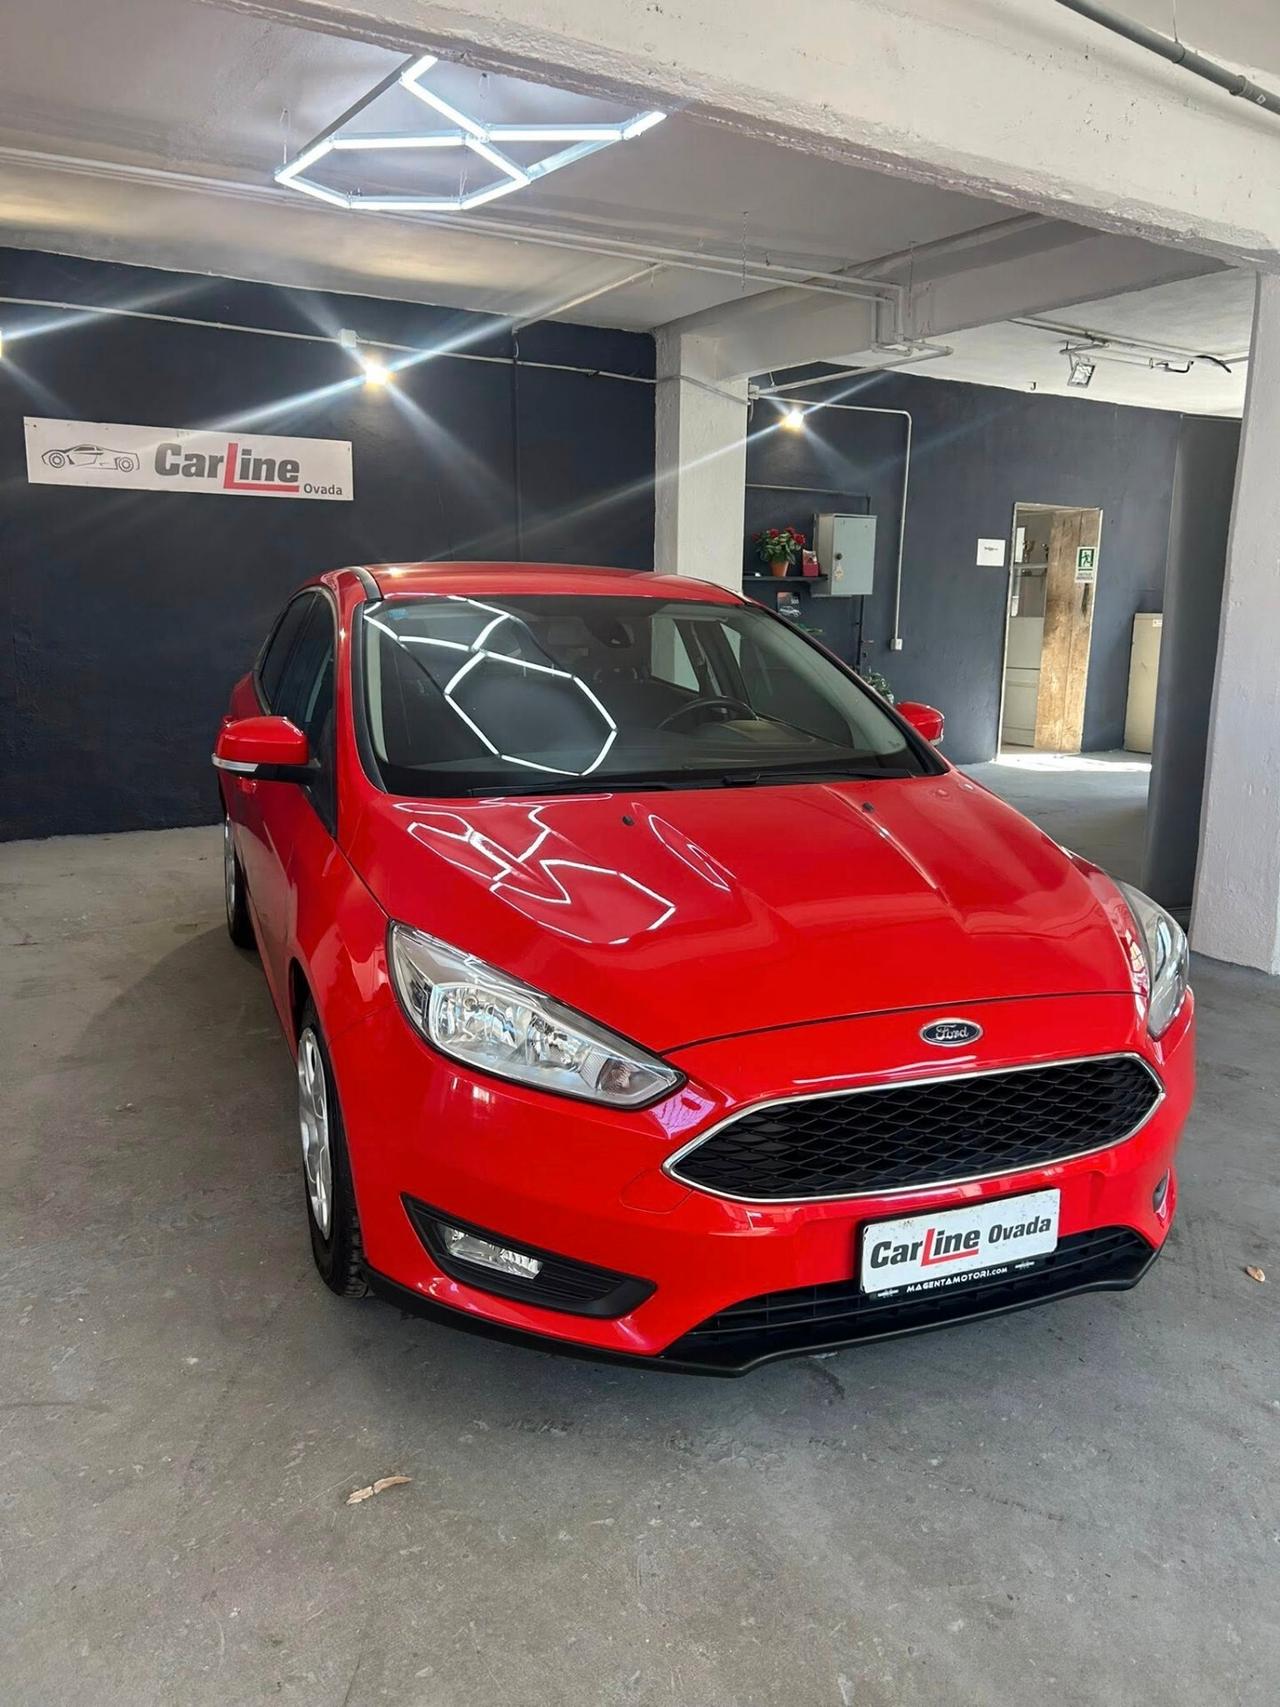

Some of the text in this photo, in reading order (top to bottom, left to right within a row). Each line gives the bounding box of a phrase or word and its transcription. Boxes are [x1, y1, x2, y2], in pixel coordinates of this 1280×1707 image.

[154, 442, 343, 496] CarLine Ovada
[934, 1024, 970, 1041] Ford
[870, 1215, 1051, 1269] CarLine Ovada
